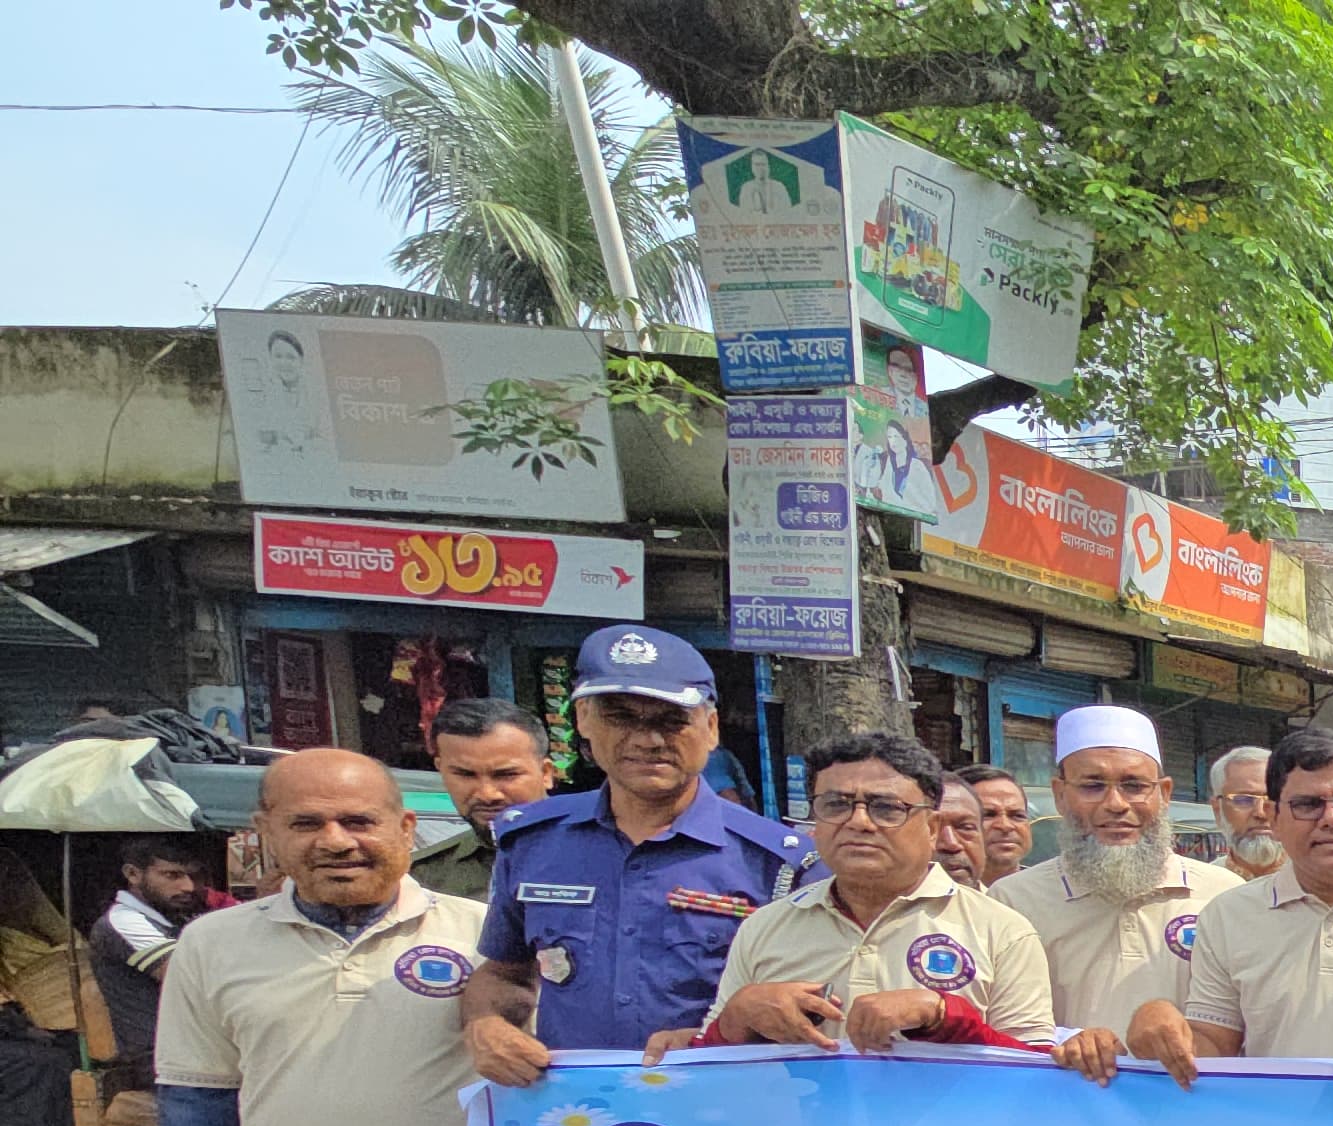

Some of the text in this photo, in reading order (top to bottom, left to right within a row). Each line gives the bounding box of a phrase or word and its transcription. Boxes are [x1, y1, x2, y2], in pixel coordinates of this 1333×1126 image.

[914, 181, 943, 200] Packly
[999, 274, 1058, 315] Packly
[722, 331, 847, 364] রুবিয়া-ফয়েজ
[730, 441, 846, 467] ডাঃ জেসমিন নাহার
[1000, 474, 1118, 539] বাংলালিংক
[268, 545, 395, 572] ক্যাশ আউট
[1061, 532, 1095, 555] আপনার
[580, 567, 613, 586] বিকাশ
[1178, 538, 1264, 586] বাংলালিংক
[734, 597, 848, 630] রুবিয়া-ফয়েজ
